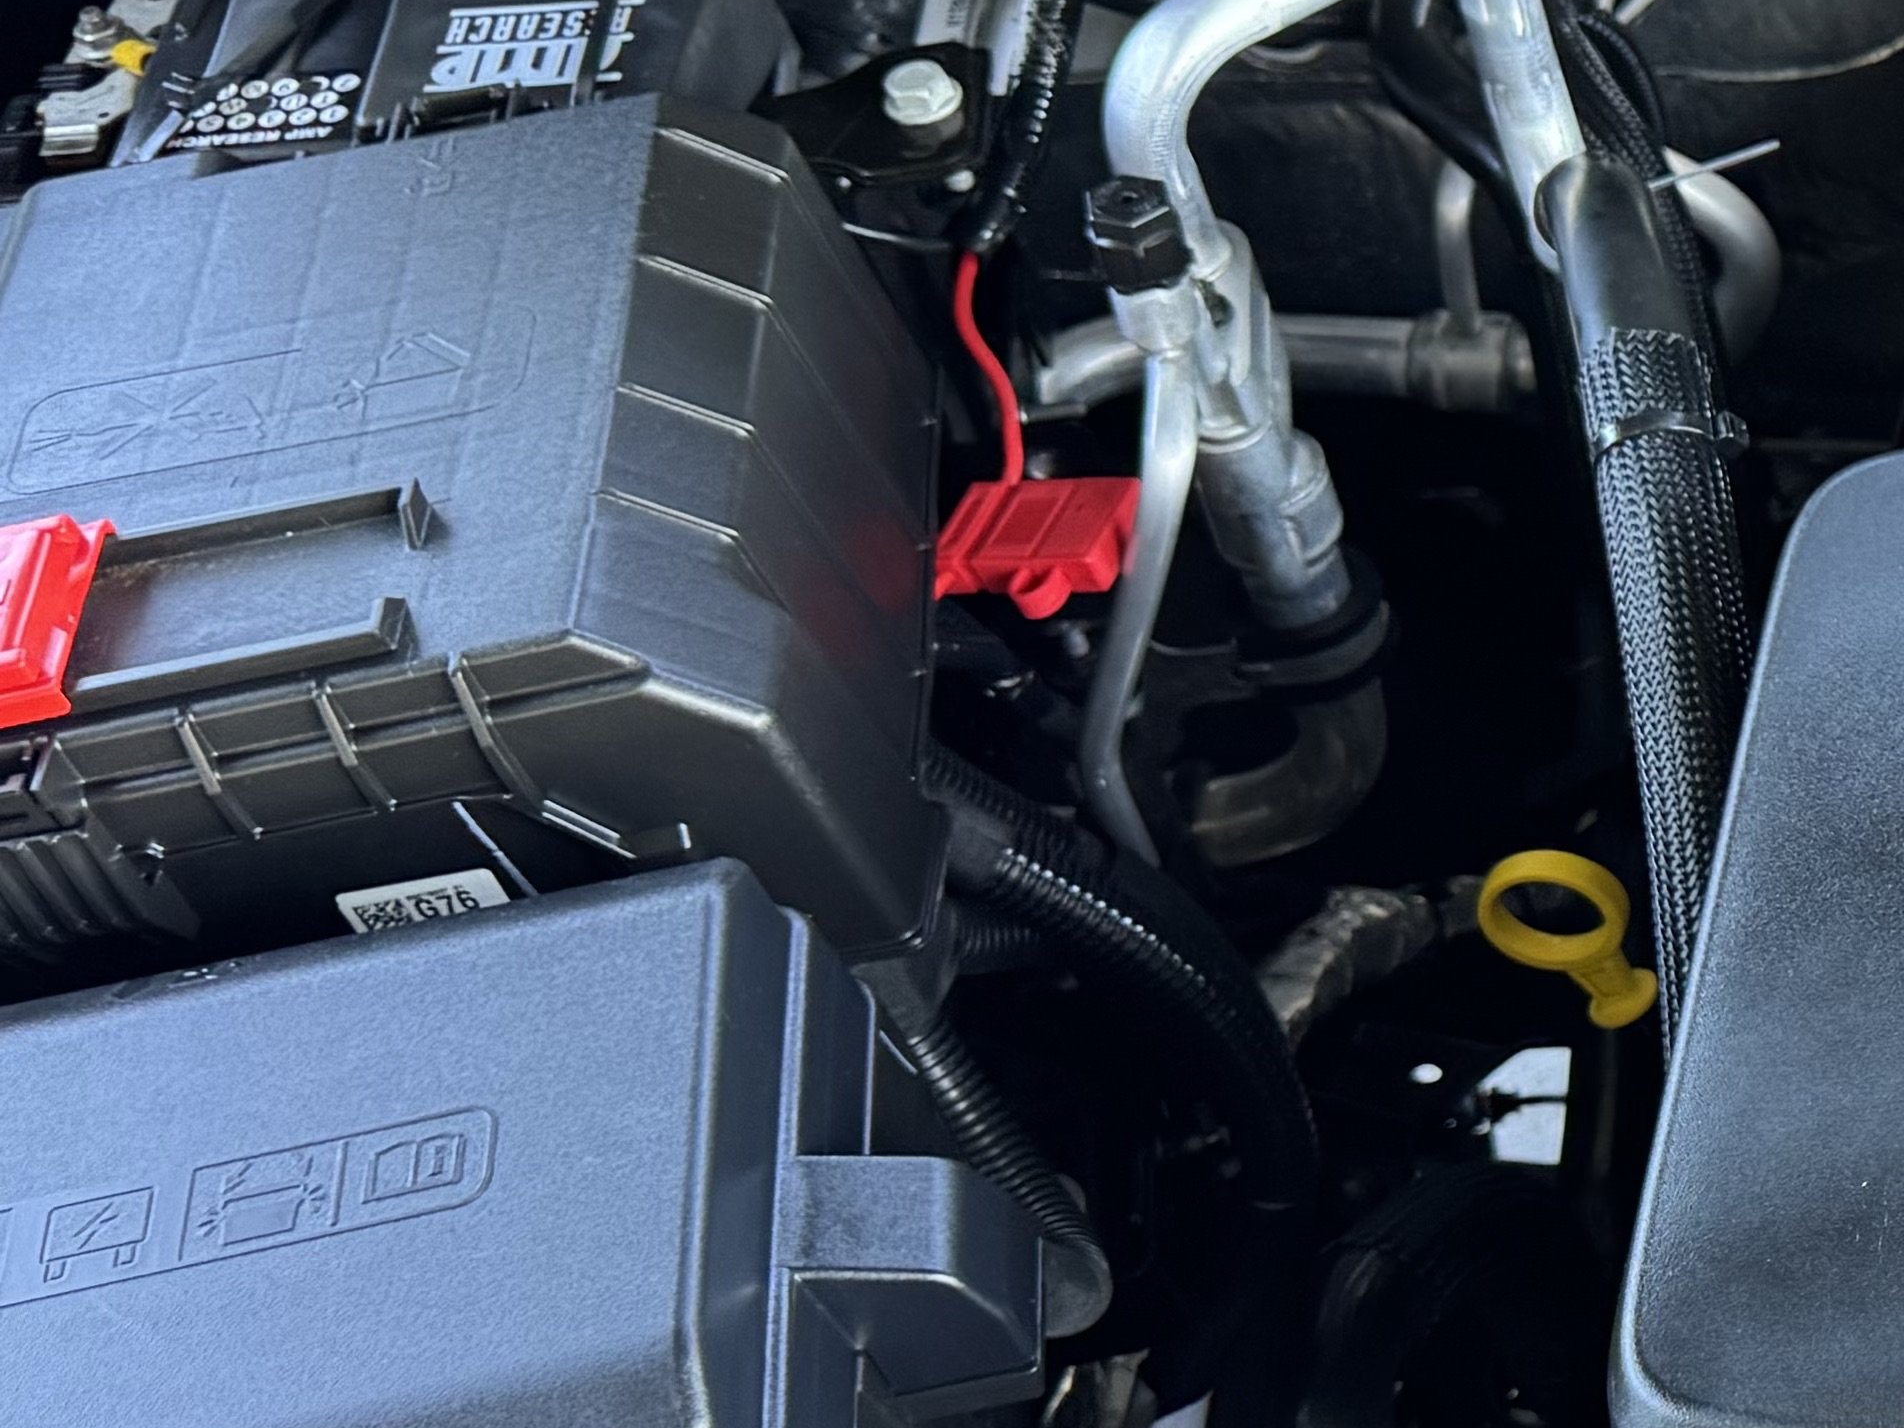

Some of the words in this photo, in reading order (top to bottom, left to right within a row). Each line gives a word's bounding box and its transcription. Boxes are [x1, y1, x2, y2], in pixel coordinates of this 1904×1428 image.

[446, 8, 634, 44] RSEARCH
[284, 125, 333, 140] AMP
[413, 889, 481, 921] G76
